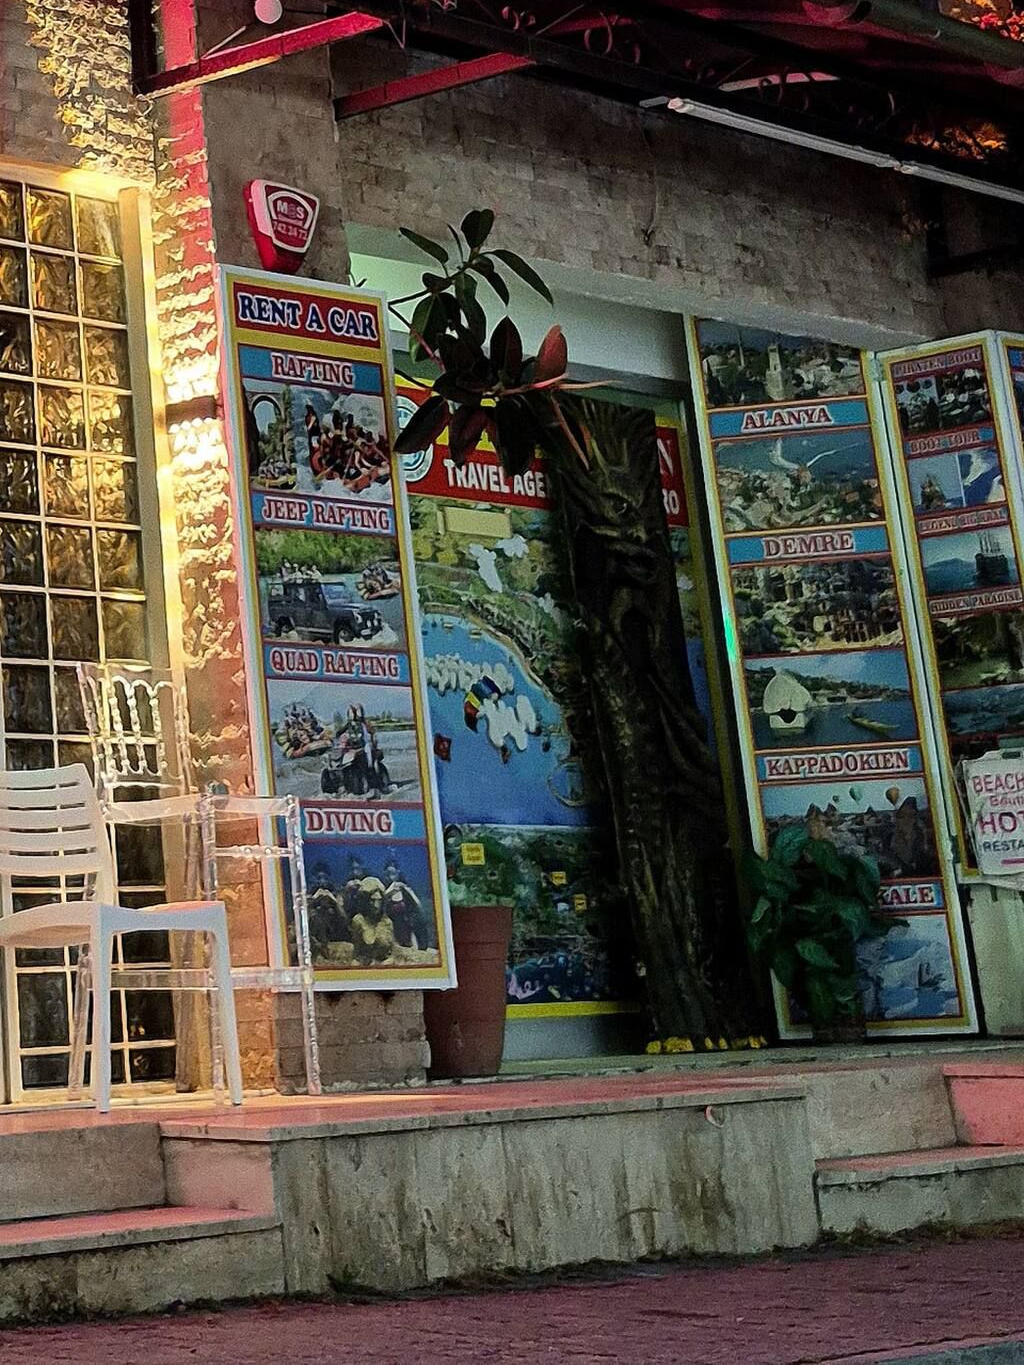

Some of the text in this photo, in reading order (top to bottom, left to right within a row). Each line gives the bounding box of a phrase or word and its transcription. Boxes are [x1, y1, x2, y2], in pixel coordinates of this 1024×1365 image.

[237, 292, 378, 341] RENT A CAR
[270, 352, 355, 389] RAFTING
[740, 405, 834, 433] ALANYA
[443, 458, 547, 498] TRAVEL AGE
[263, 497, 391, 533] JEEP RAFTING
[763, 531, 855, 558] DEMRE
[270, 646, 400, 681] QUAD RAFTING
[764, 748, 911, 780] KAPPADOKIEN
[304, 807, 395, 835] DIVING
